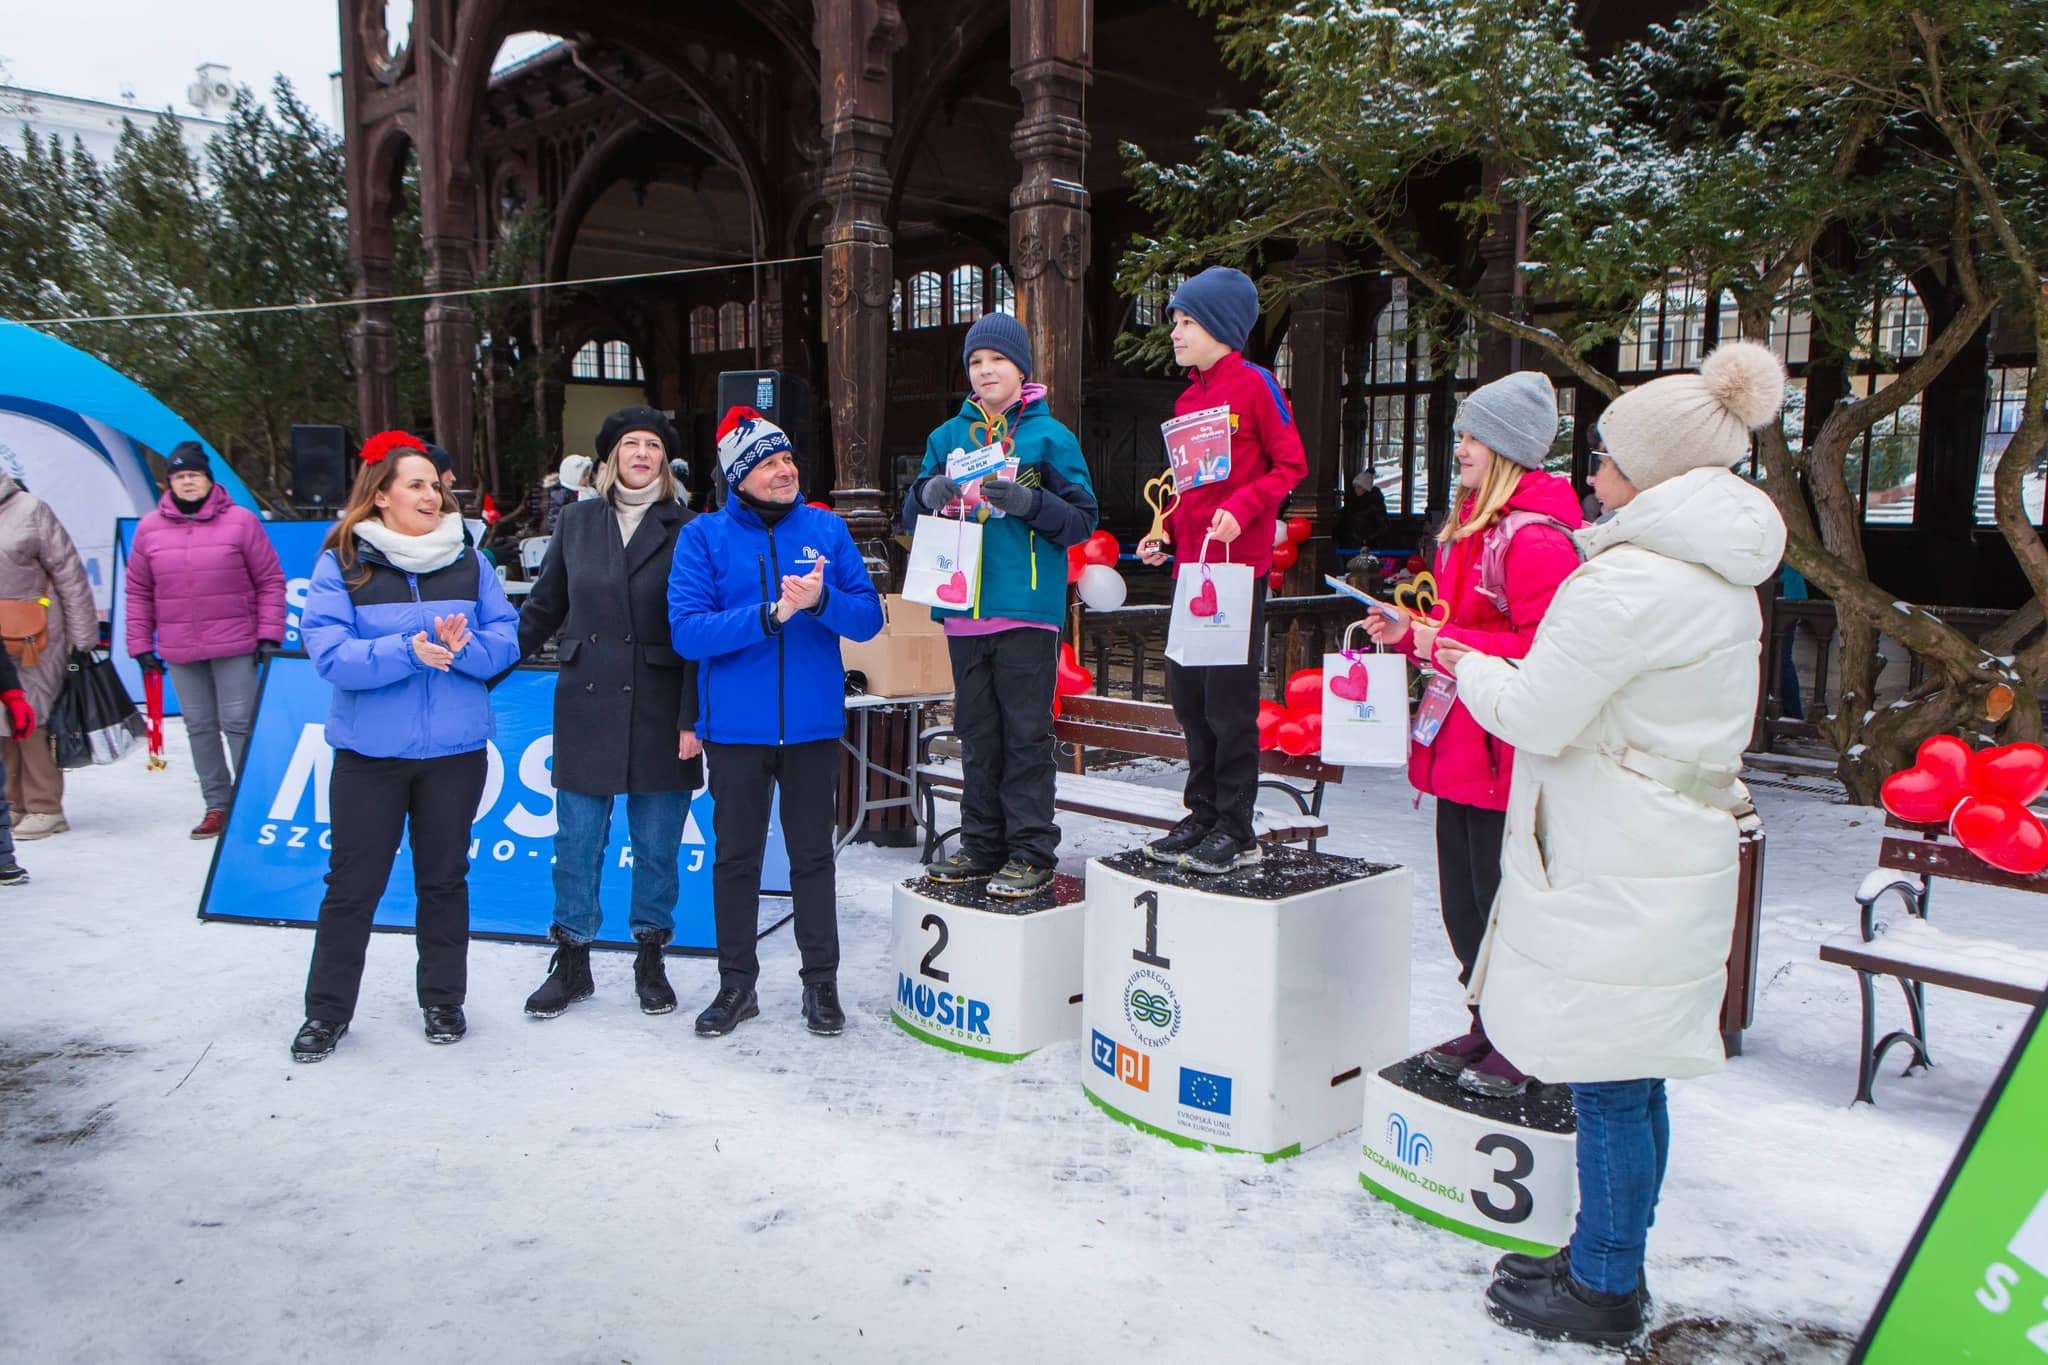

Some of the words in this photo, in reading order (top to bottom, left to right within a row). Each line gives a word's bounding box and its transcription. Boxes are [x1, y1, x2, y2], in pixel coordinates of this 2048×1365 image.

[920, 913, 950, 984] 2
[1132, 890, 1170, 970] 1
[1128, 968, 1176, 999] EUROREGION
[1130, 1023, 1170, 1049] GLACENSIS
[1361, 1144, 1465, 1204] SZCZAWNO-ZDRÓJ
[1470, 1133, 1535, 1225] 3
